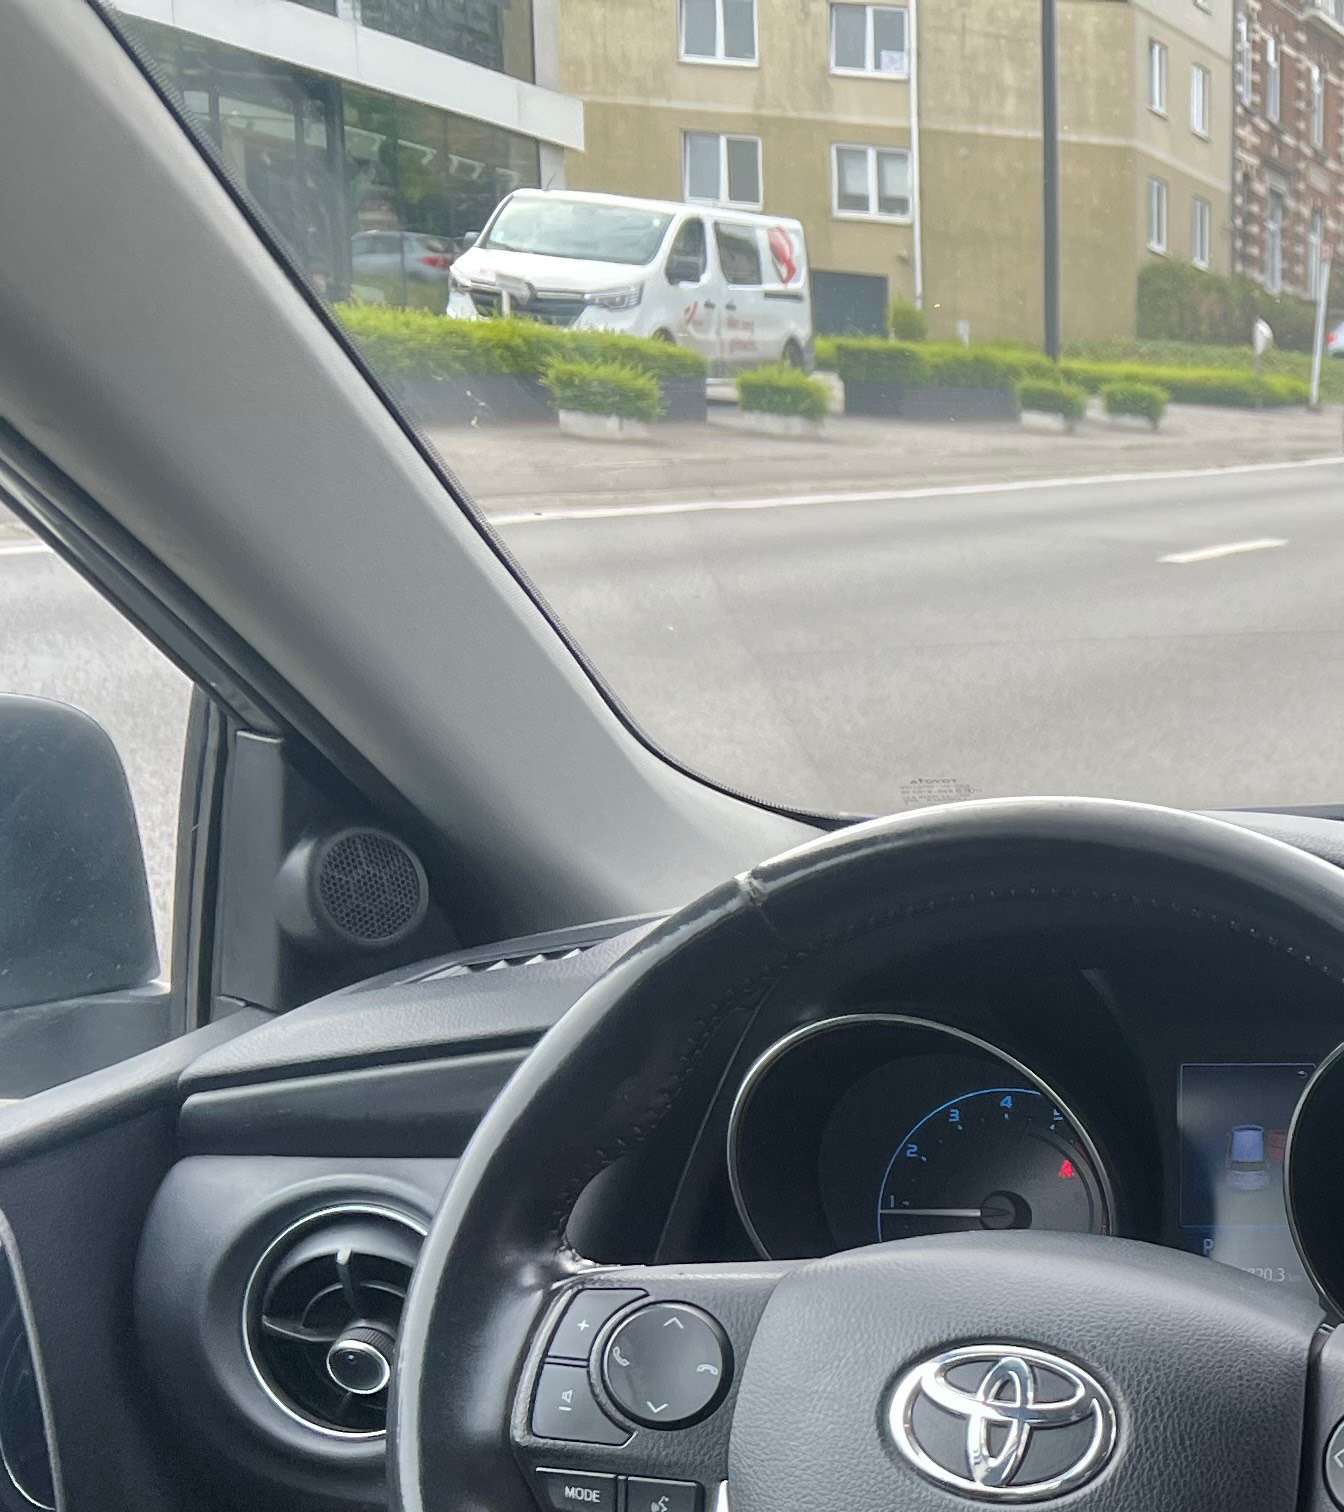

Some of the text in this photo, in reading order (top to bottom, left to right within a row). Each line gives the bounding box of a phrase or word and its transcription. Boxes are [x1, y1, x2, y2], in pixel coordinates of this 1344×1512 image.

[1000, 1096, 1012, 1108] 4
[948, 1108, 960, 1121] 3
[906, 1144, 918, 1157] 2
[565, 1485, 601, 1503] MODE
